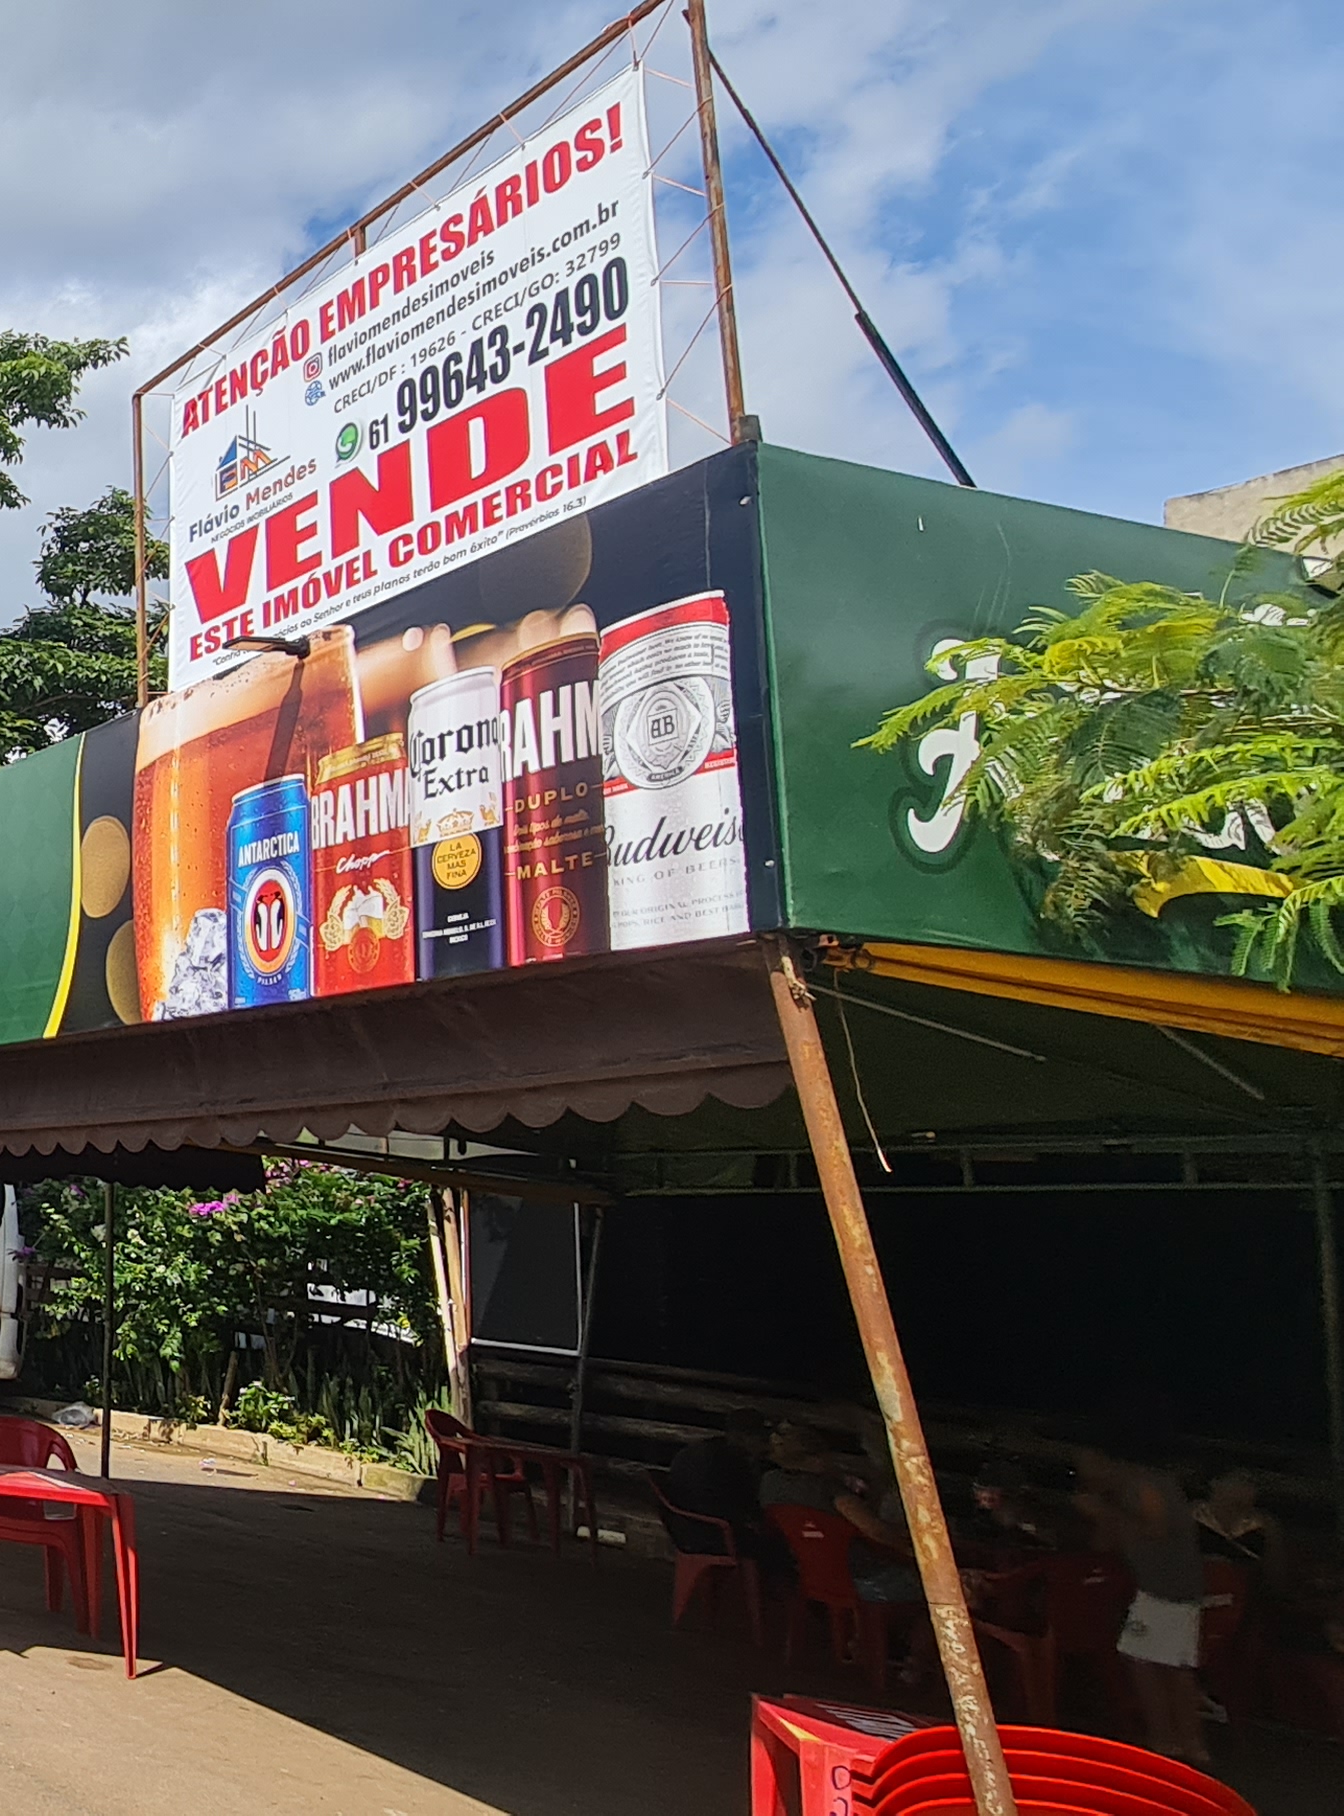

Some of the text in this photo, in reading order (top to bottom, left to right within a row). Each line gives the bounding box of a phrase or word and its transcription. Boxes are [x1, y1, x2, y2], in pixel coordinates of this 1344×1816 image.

[181, 102, 623, 439] ATENÇÃO EMPRESÁRIOS!
[328, 249, 496, 367] flaviomendesimoveis
[329, 199, 621, 391] www.flaviomendesimoveis.com.br
[410, 330, 456, 366] 19626
[471, 273, 560, 333] CRECI/GO:
[564, 232, 622, 278] 32799
[368, 256, 629, 451] 61 99643-2490
[184, 322, 636, 624] VENDE
[189, 458, 318, 543] Flávio Mendes
[189, 428, 638, 662] ESTE IMÓVEL COMERCIAL
[423, 765, 489, 800] Extra
[514, 781, 589, 814] DUPLO
[238, 830, 300, 867] ANTARCTICA
[335, 850, 391, 874] Chopp
[516, 851, 593, 880] MALTE
